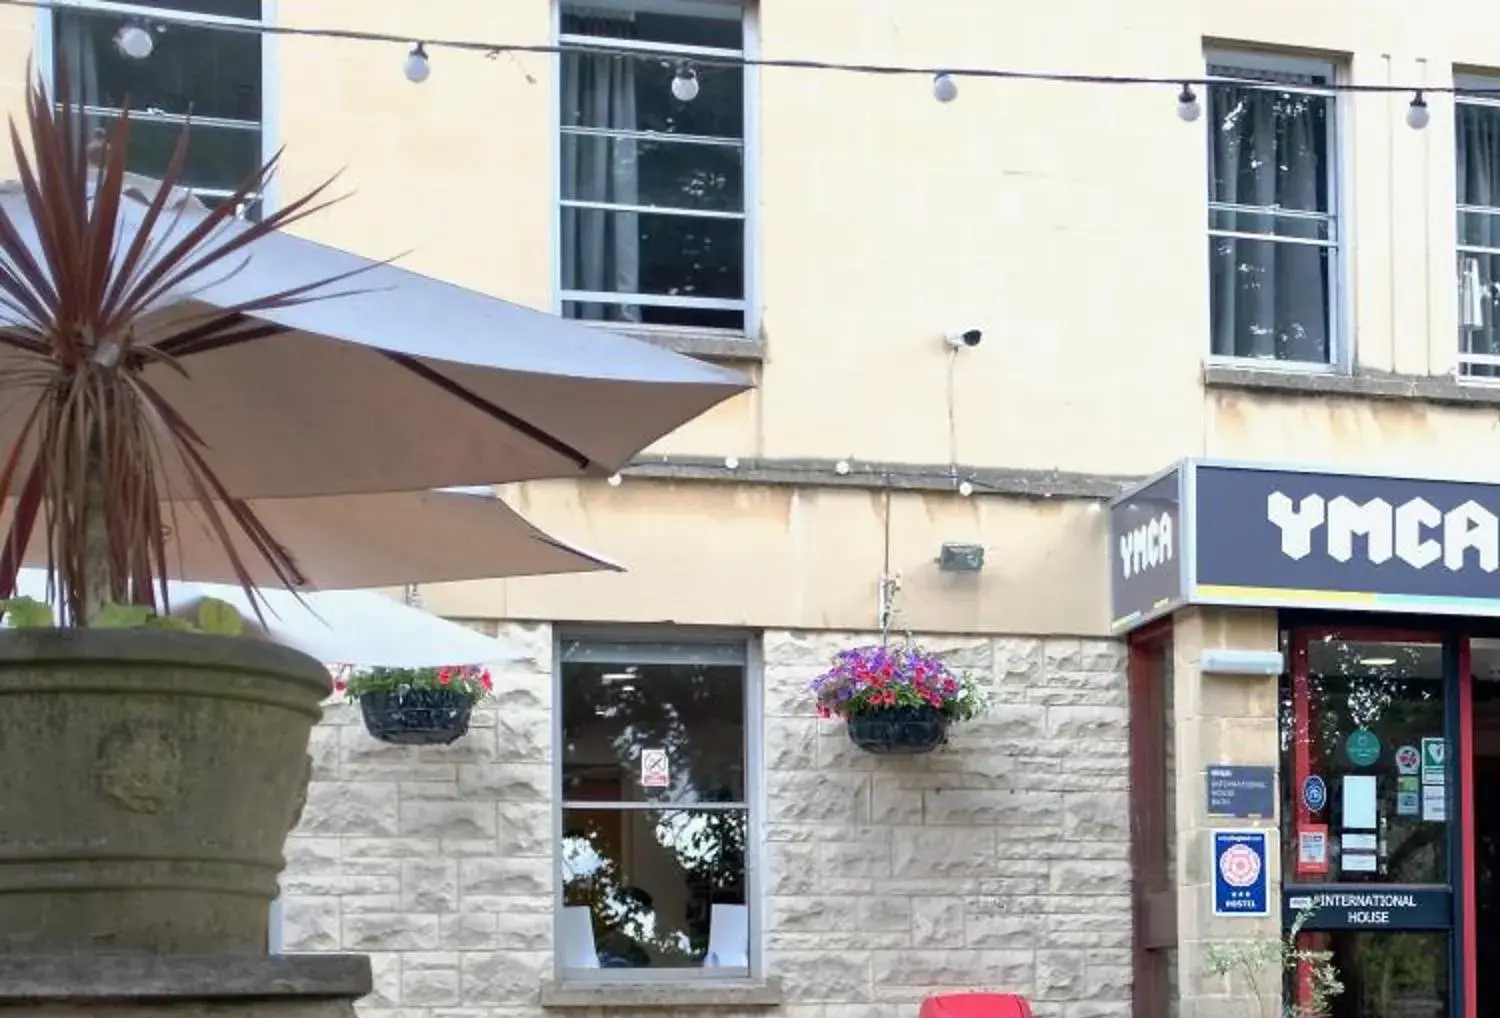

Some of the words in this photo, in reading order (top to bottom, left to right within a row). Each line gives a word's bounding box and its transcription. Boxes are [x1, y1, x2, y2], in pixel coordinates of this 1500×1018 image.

[1120, 511, 1173, 581] YMCA
[1267, 490, 1499, 574] YMCA
[1321, 894, 1417, 907] INTERNATIONAL
[1347, 911, 1390, 924] HOUSE
